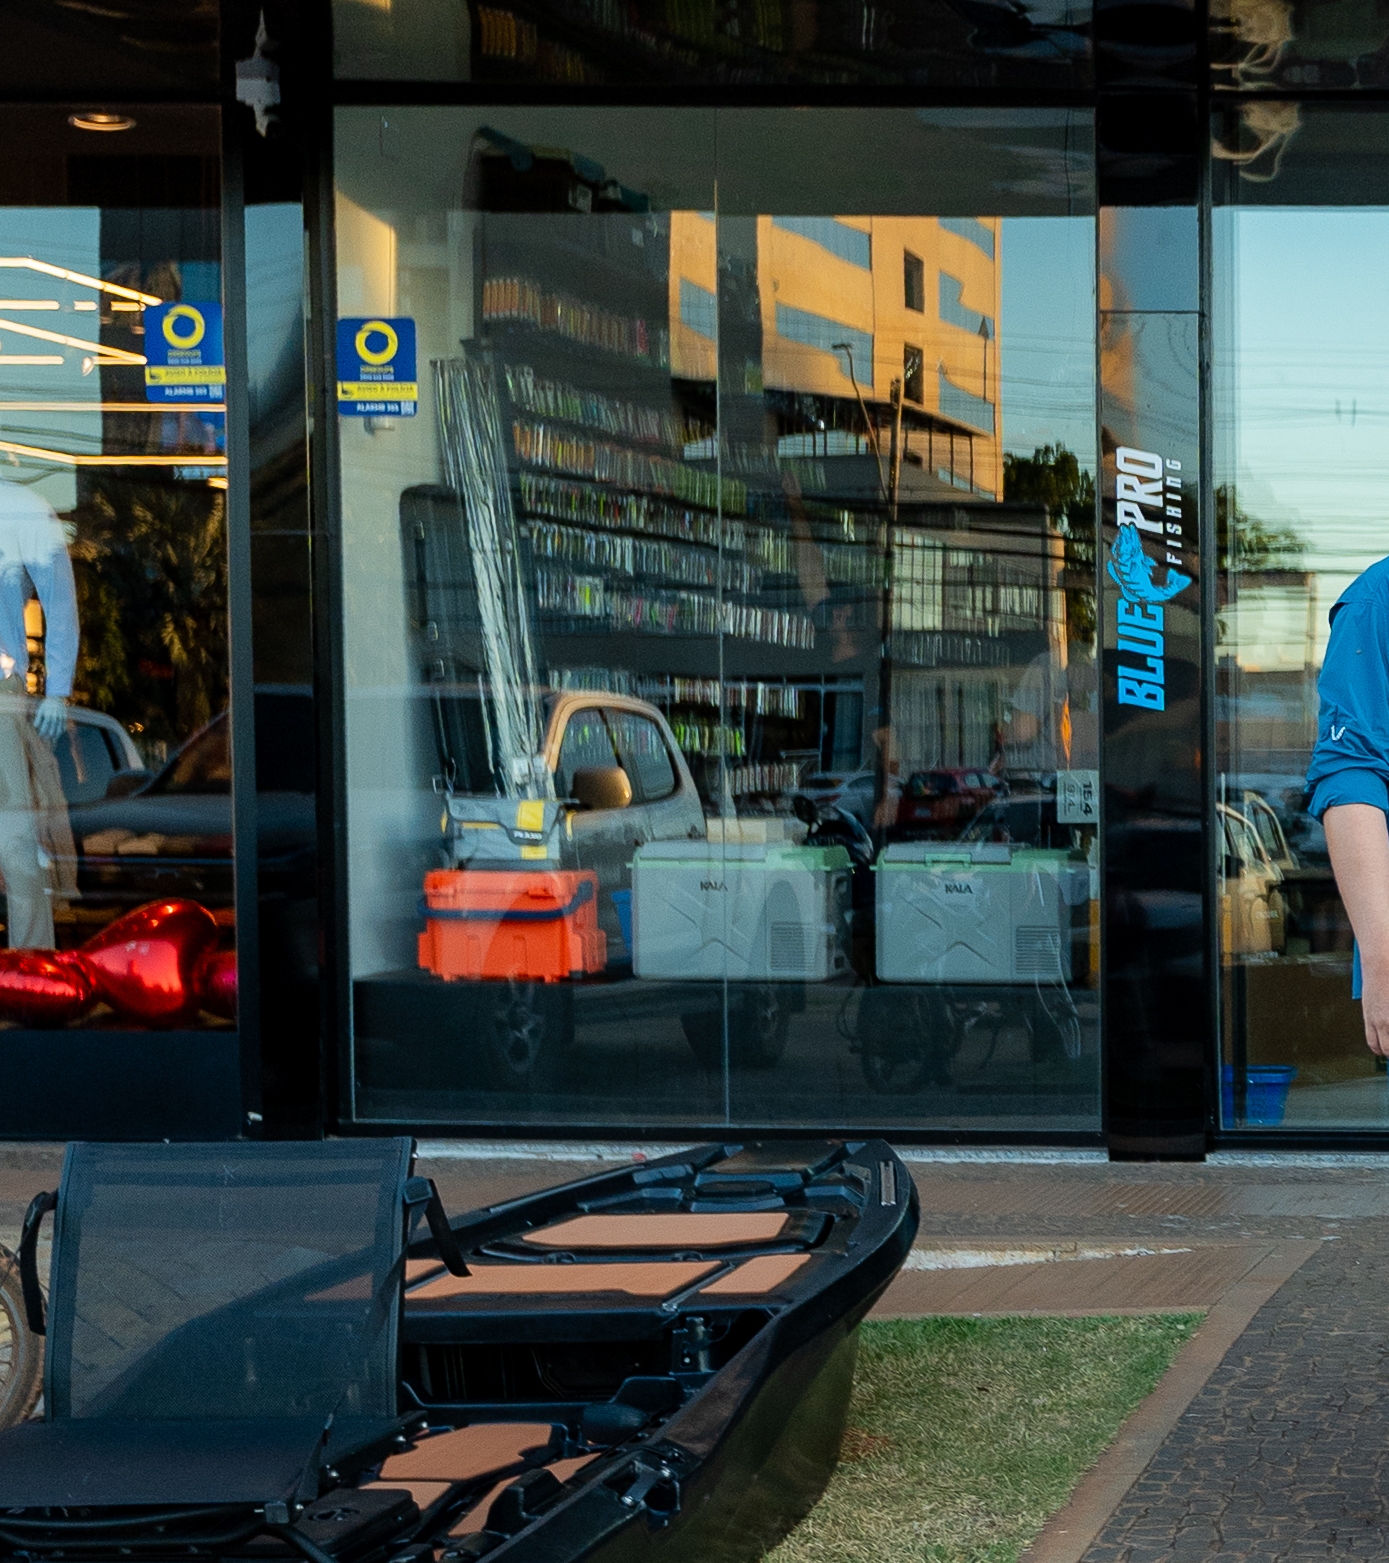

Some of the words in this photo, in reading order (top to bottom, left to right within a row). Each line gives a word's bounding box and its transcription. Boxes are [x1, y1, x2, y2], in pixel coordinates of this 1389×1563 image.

[1116, 446, 1164, 535] PRO
[1166, 458, 1183, 566] FISHING
[1117, 597, 1165, 712] BLUE
